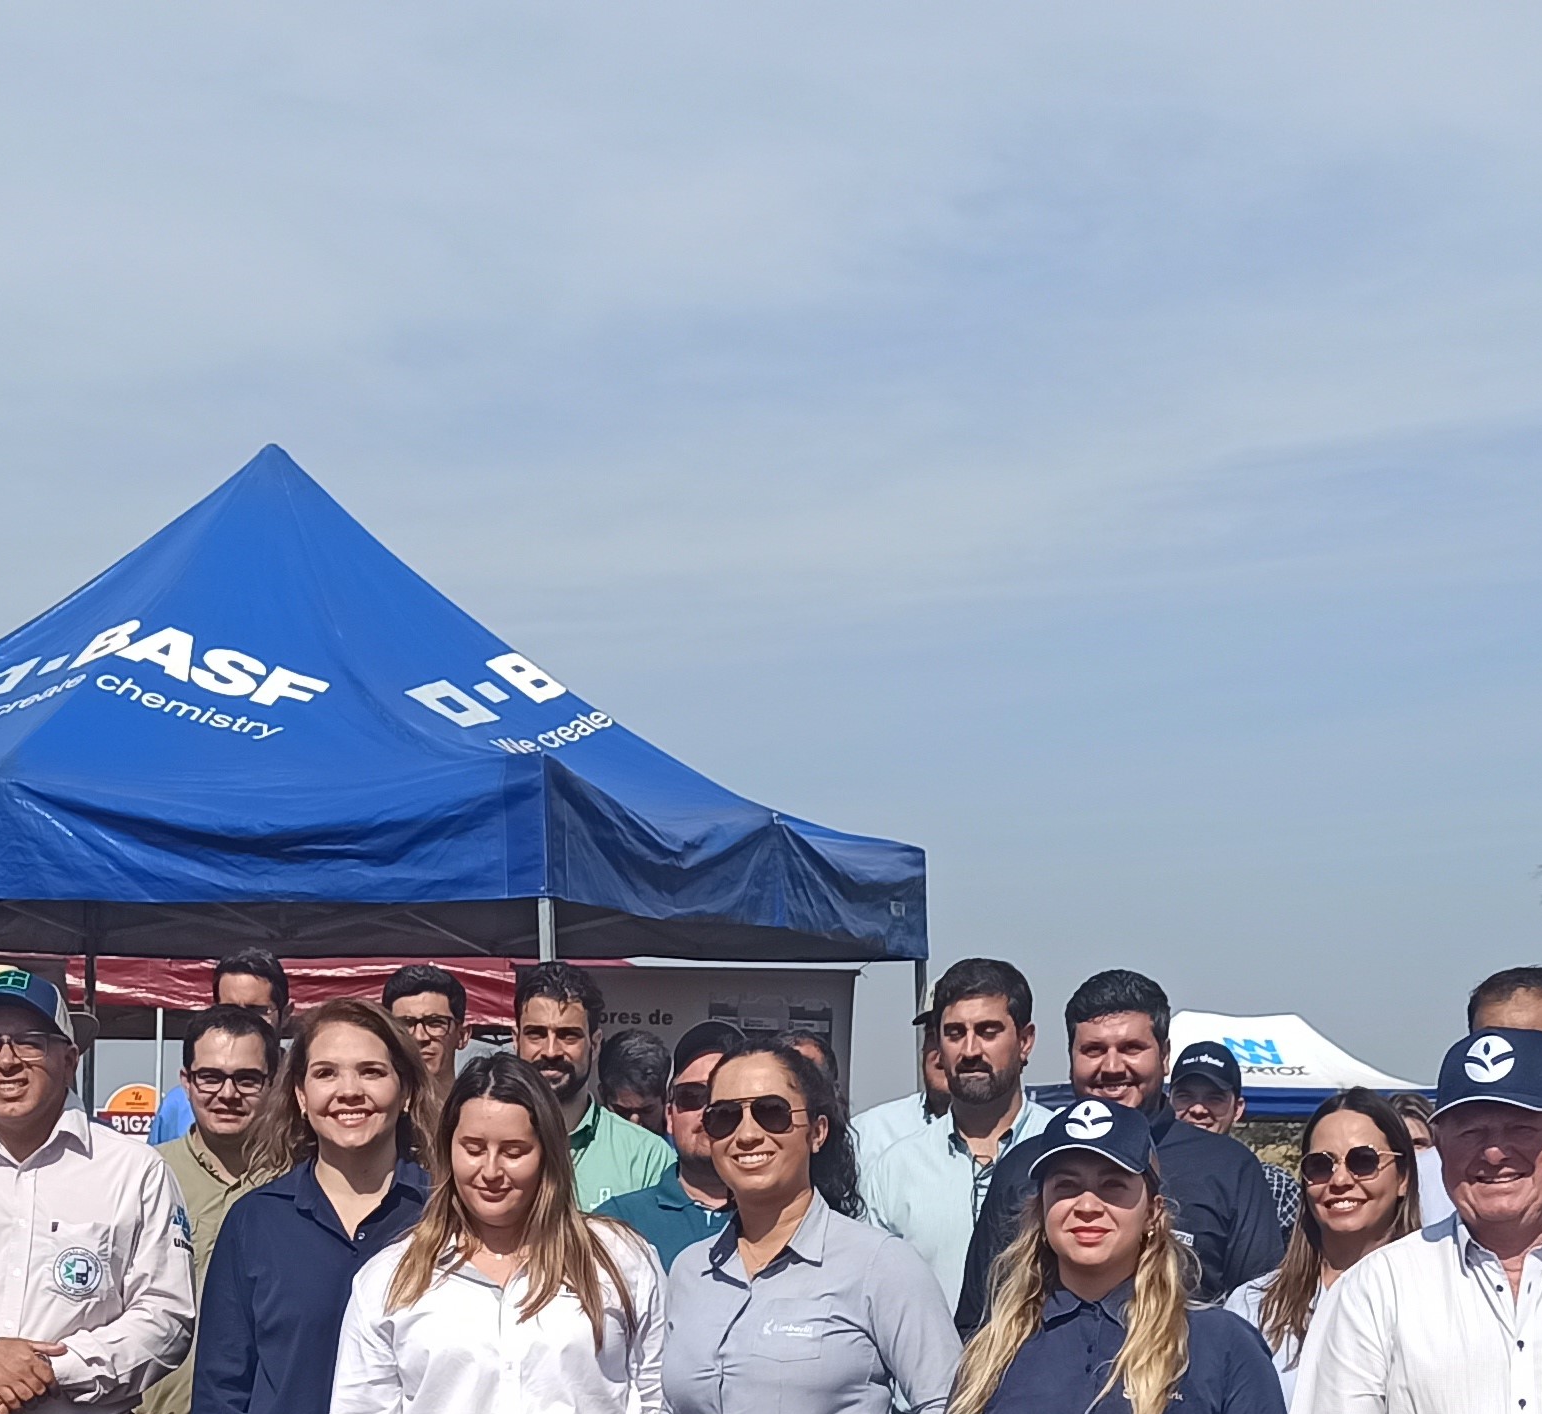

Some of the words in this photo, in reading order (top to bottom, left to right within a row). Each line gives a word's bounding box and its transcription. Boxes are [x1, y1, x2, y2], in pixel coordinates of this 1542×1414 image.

[69, 619, 330, 707] BASF
[96, 673, 287, 741] chemistry
[538, 711, 613, 749] create
[649, 1008, 674, 1026] de
